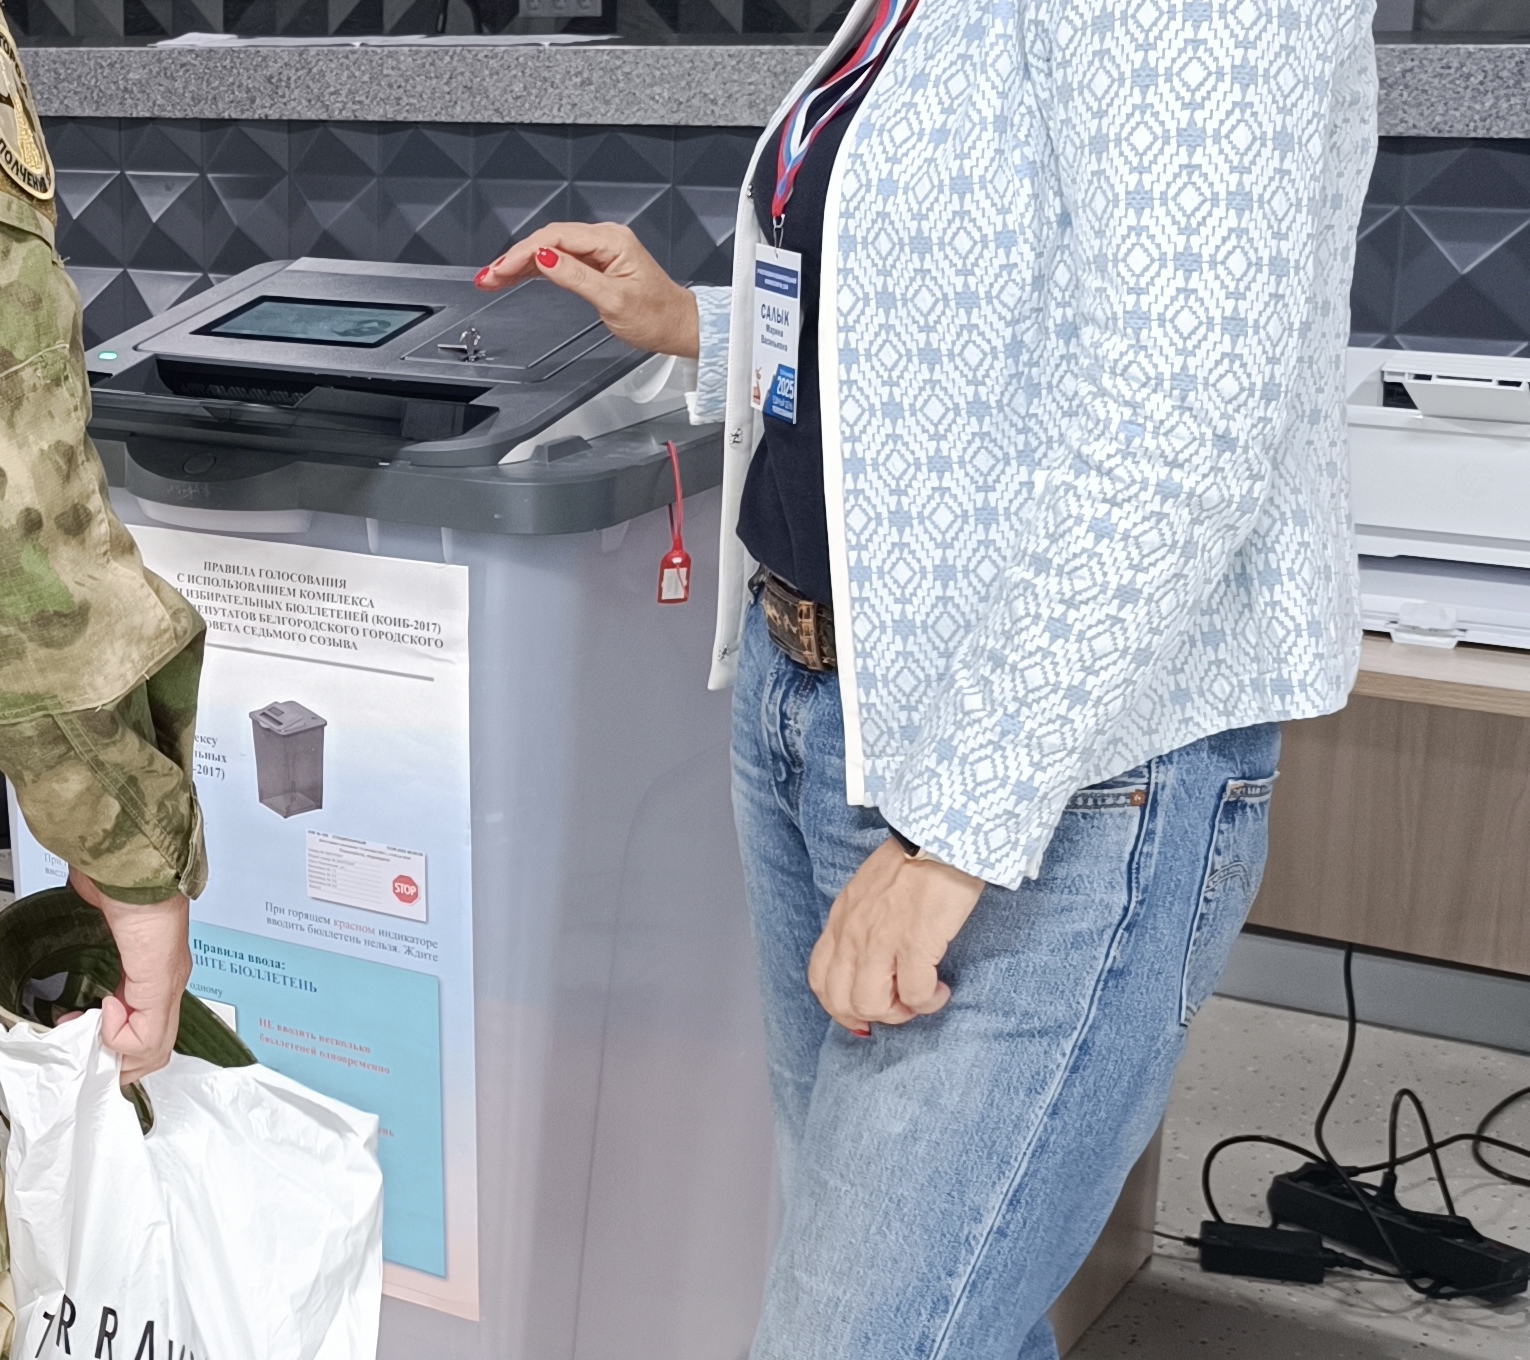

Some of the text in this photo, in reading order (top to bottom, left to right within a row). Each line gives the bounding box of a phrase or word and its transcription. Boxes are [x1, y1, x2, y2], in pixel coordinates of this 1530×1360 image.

[761, 303, 790, 327] САЛЫК
[176, 573, 375, 609] С ИСПОЛЬЗОВАНИЕМ КОМПЛЕКСА
[203, 561, 347, 590] ПРАВИЛА ГОЛОСОВАНИЯ
[186, 589, 442, 635] ИЗБИРАТЕЛЬНЫХ БЮЛЛЕТЕНЕЙ (КОИБ-2017)
[205, 620, 358, 651] ОВЕТА СЕДЬМОГО СОЗЫВА
[259, 613, 359, 637] БЕЛГОРОДСКОГО
[362, 626, 444, 649] ГОРОДСКОГО
[395, 882, 416, 896] STOP
[265, 901, 438, 950] При горящем красном индикаторе
[266, 917, 438, 963] вводить бюллетень нельзя. Ждите
[193, 938, 286, 970] Правила ввода:
[194, 954, 318, 993] ДИТЕ БЮЛЛЕТЕНЬ
[259, 1018, 371, 1054] НЕ вводить несколько
[259, 1033, 391, 1075] бюллетеней одновременно
